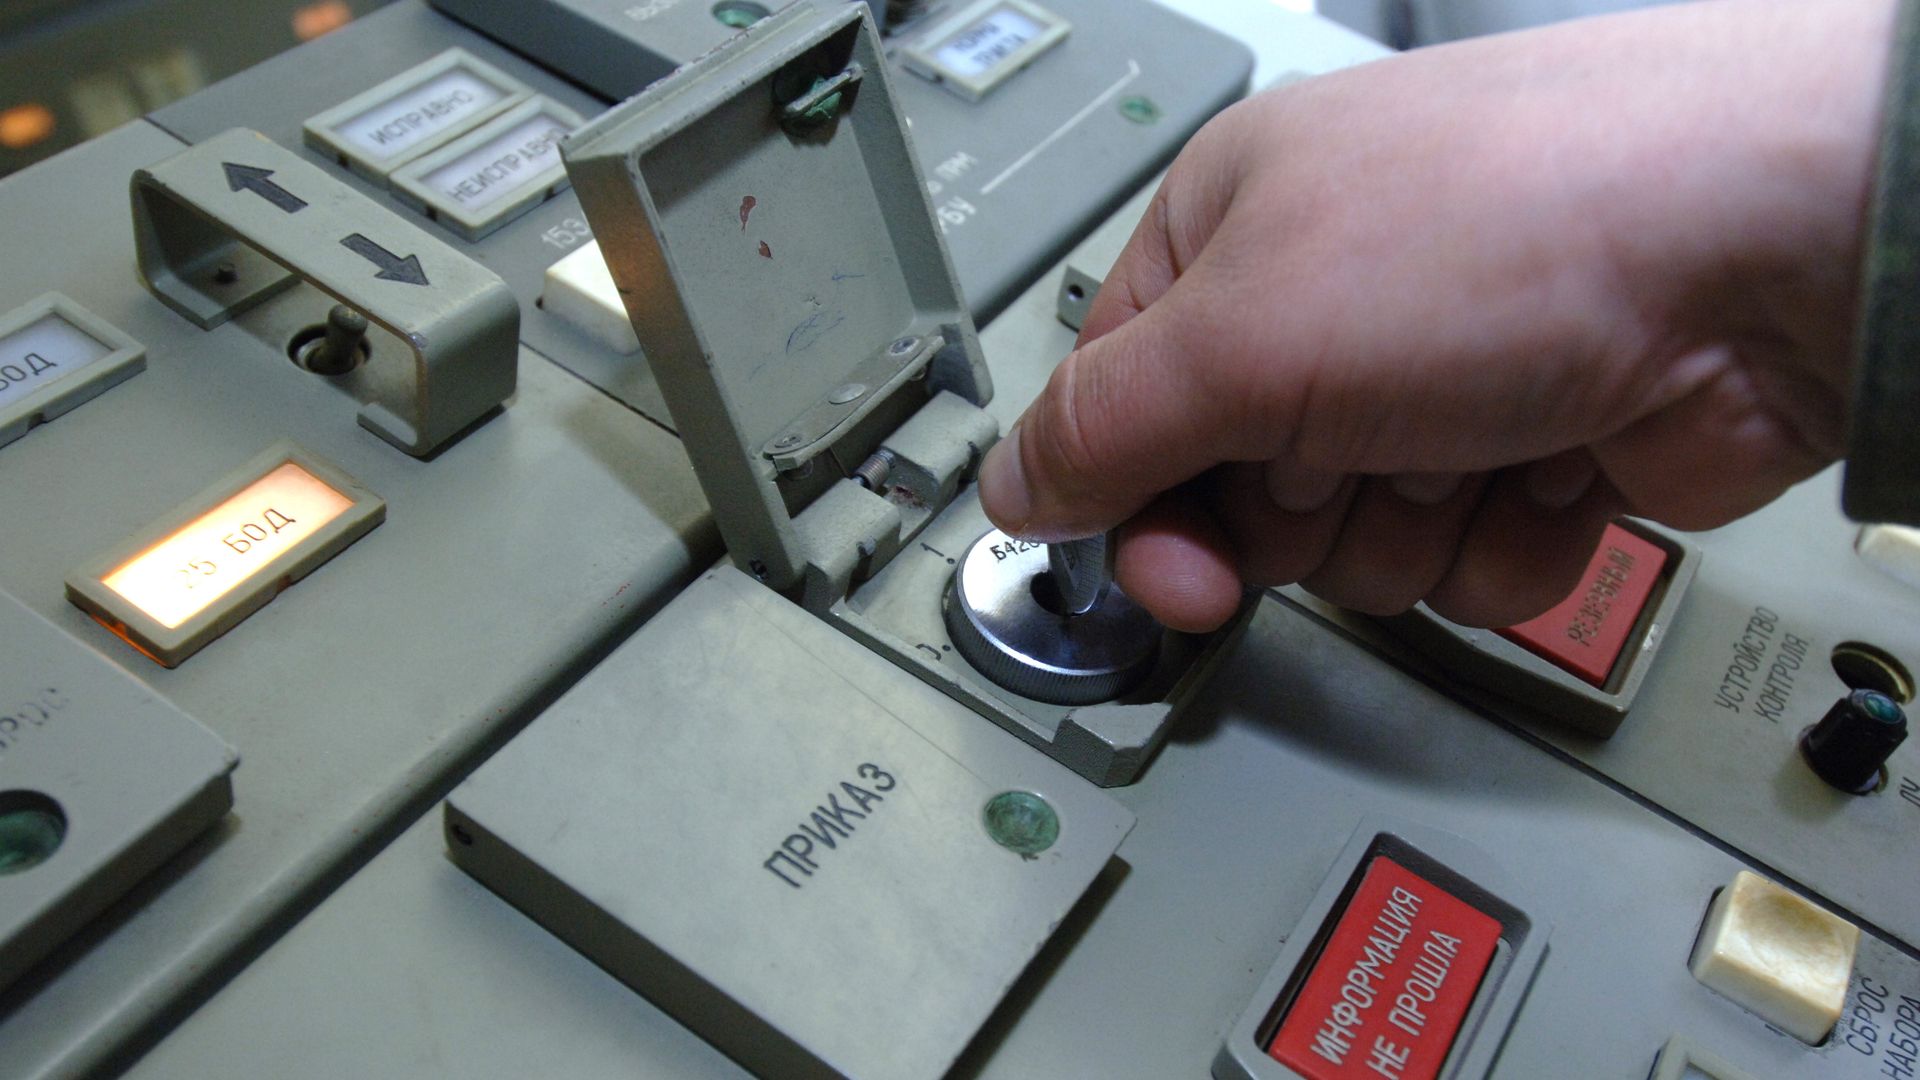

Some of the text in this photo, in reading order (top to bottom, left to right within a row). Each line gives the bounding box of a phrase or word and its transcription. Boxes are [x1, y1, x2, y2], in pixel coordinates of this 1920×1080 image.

[369, 89, 473, 146] ИСПРАВНО
[222, 508, 296, 554] БОД
[1713, 605, 1779, 713] УСТРОЙСТВО
[1753, 632, 1810, 724] КОНТРОЛЯ
[763, 762, 896, 888] ПРИКАЗ
[1309, 886, 1423, 1066] ИНФОРМАЦИЯ
[1364, 930, 1462, 1080] НЕ ПРОШЛА
[1845, 977, 1889, 1056] СБРОС
